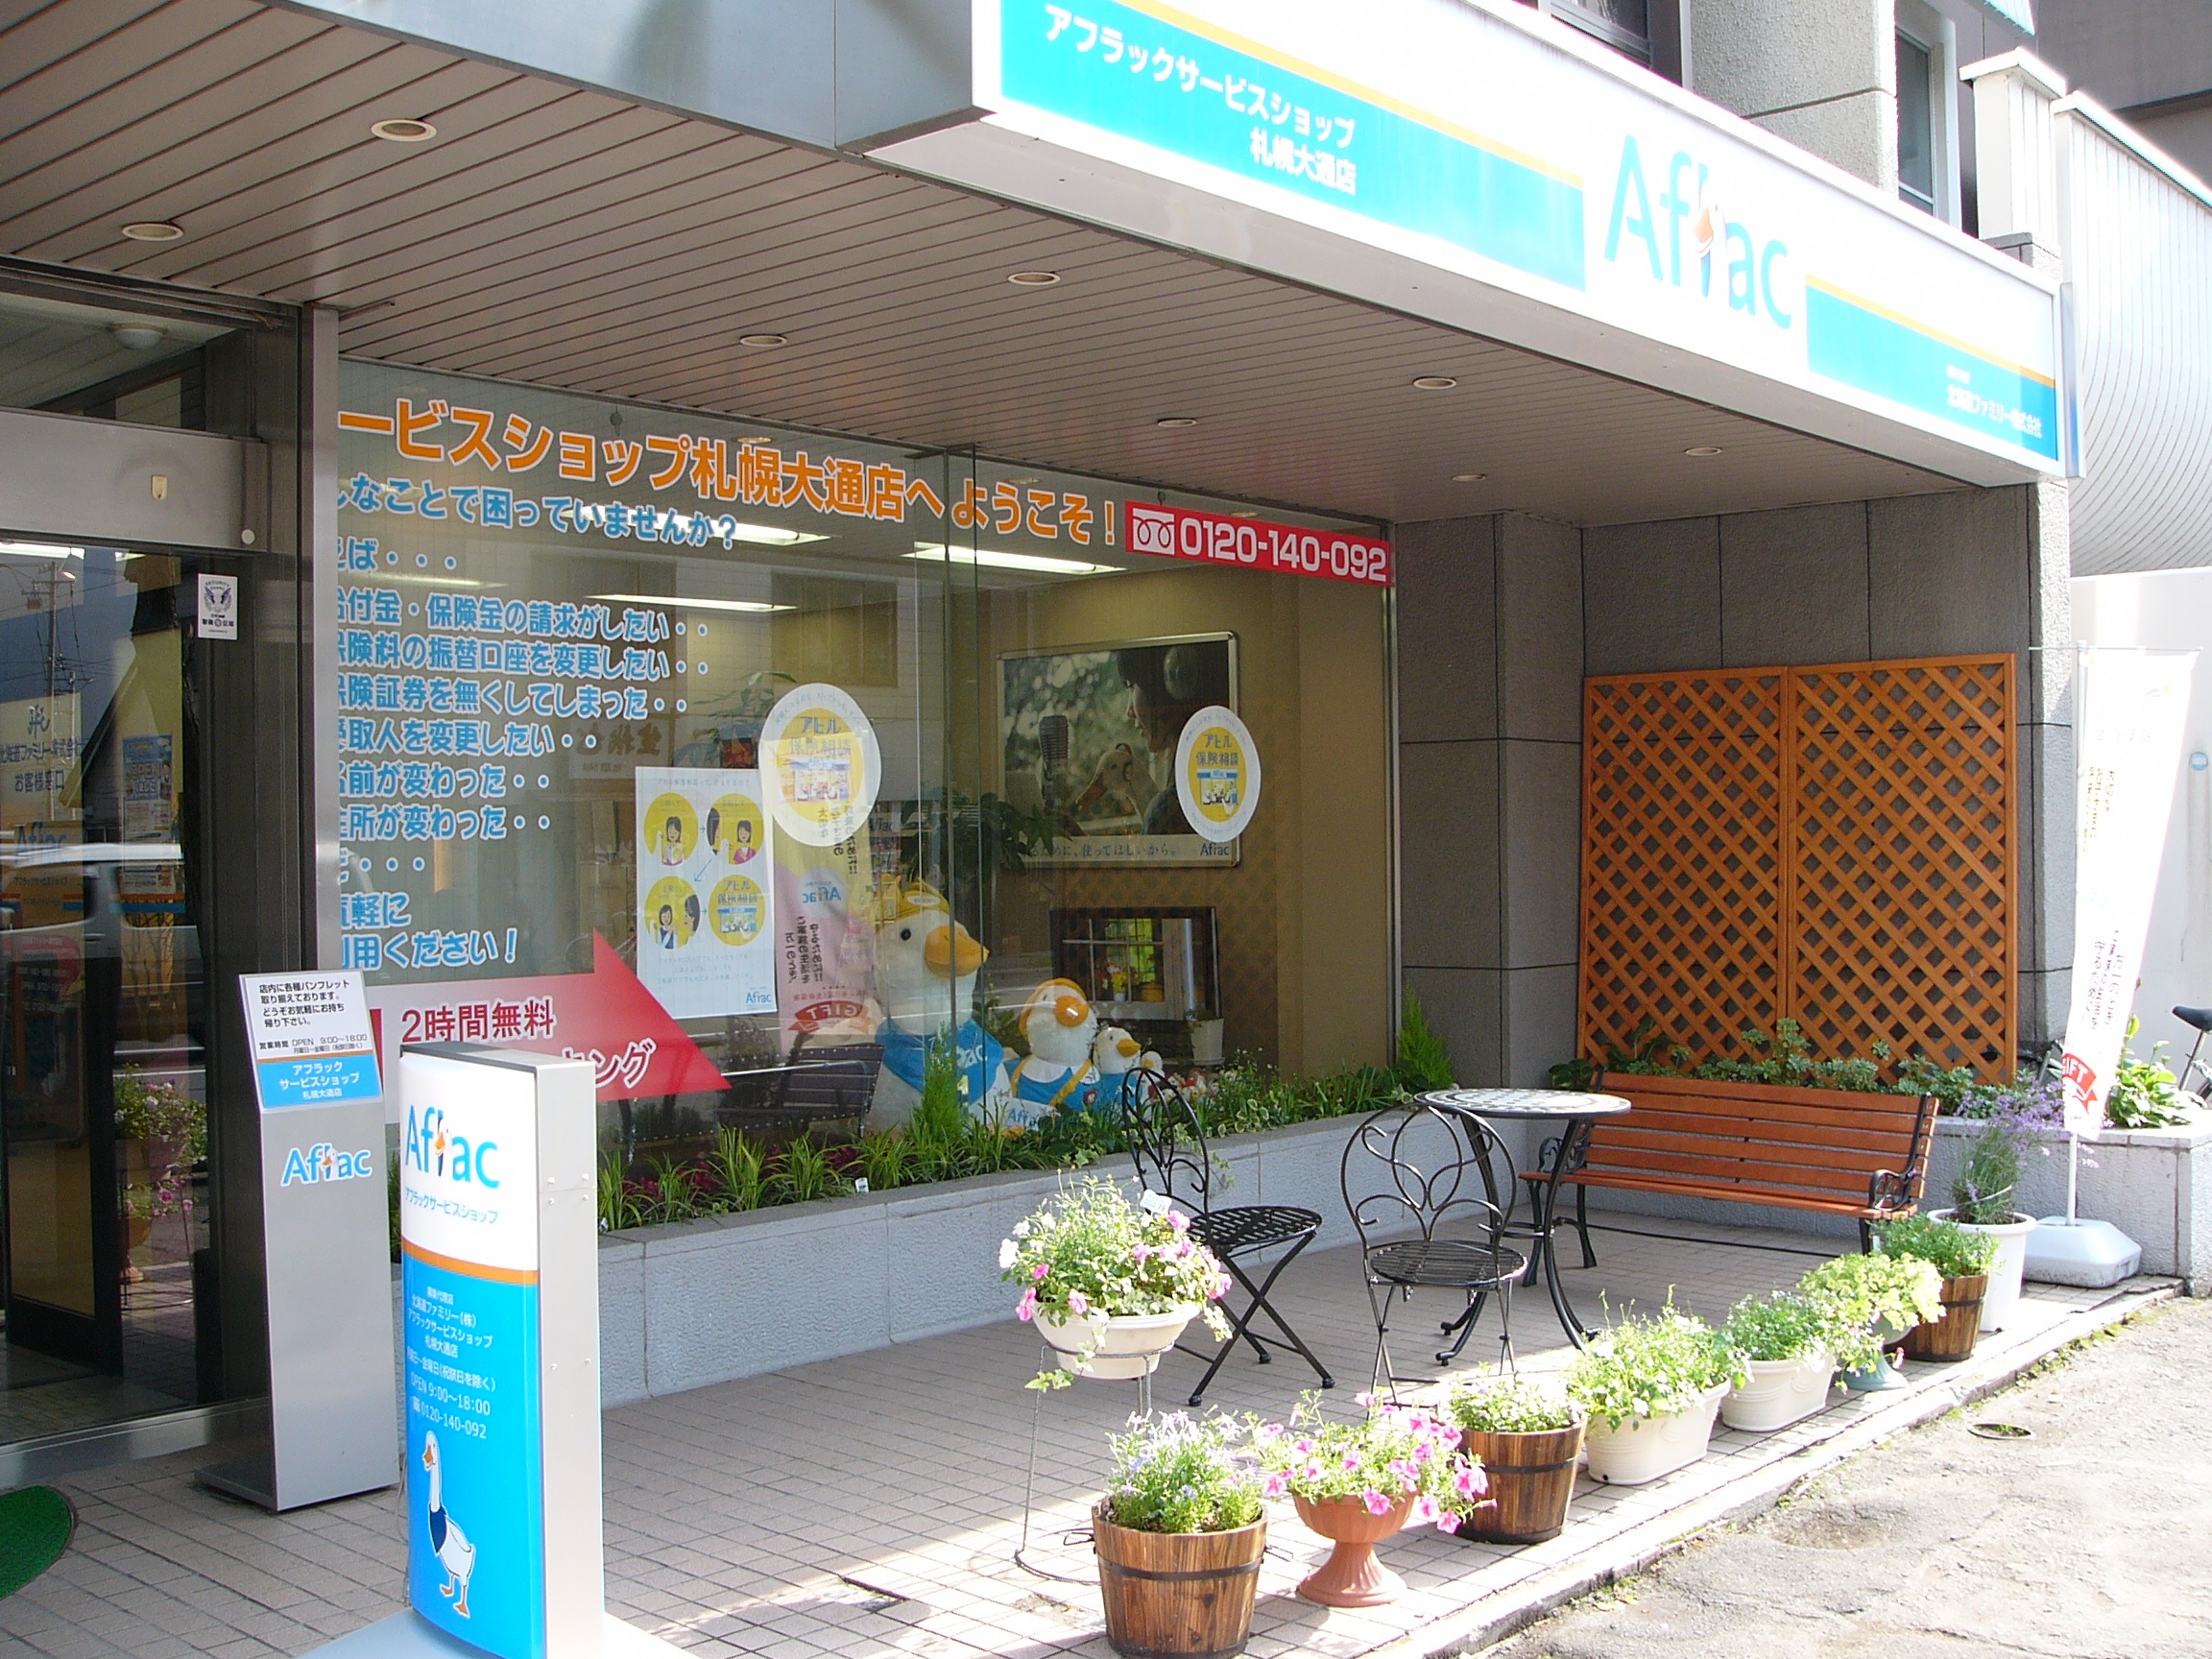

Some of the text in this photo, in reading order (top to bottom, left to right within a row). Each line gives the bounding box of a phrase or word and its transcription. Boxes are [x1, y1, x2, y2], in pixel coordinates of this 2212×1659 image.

[1045, 4, 1355, 149] アフラックサービスショップ
[1250, 127, 1357, 196] 札幌大通店
[1604, 134, 1792, 329] Aflac
[1180, 517, 1387, 582] 0120-140-092
[1204, 733, 1233, 749] アヒル
[342, 927, 517, 971] 用ください！
[259, 979, 349, 994] 店内に各種パンフレット
[260, 992, 340, 1005] 取り揃えております。
[263, 1002, 345, 1017] どうぞお気軽にお持ち
[264, 1018, 311, 1028] 帰り下さい。
[399, 996, 556, 1043] 2時間無料
[259, 1040, 289, 1050] 営業時間
[292, 1038, 314, 1047] OPEN
[279, 1071, 360, 1091] サービスショップ
[293, 1061, 343, 1076] アフラック
[281, 1142, 373, 1186] Aflac
[405, 1105, 500, 1190] Aflac
[405, 1187, 498, 1224] アフラックサービスショップ
[407, 1308, 493, 1349] アフラックサービスショップ
[410, 1371, 427, 1394] OPEN
[421, 1400, 487, 1439] 0120-140-092
